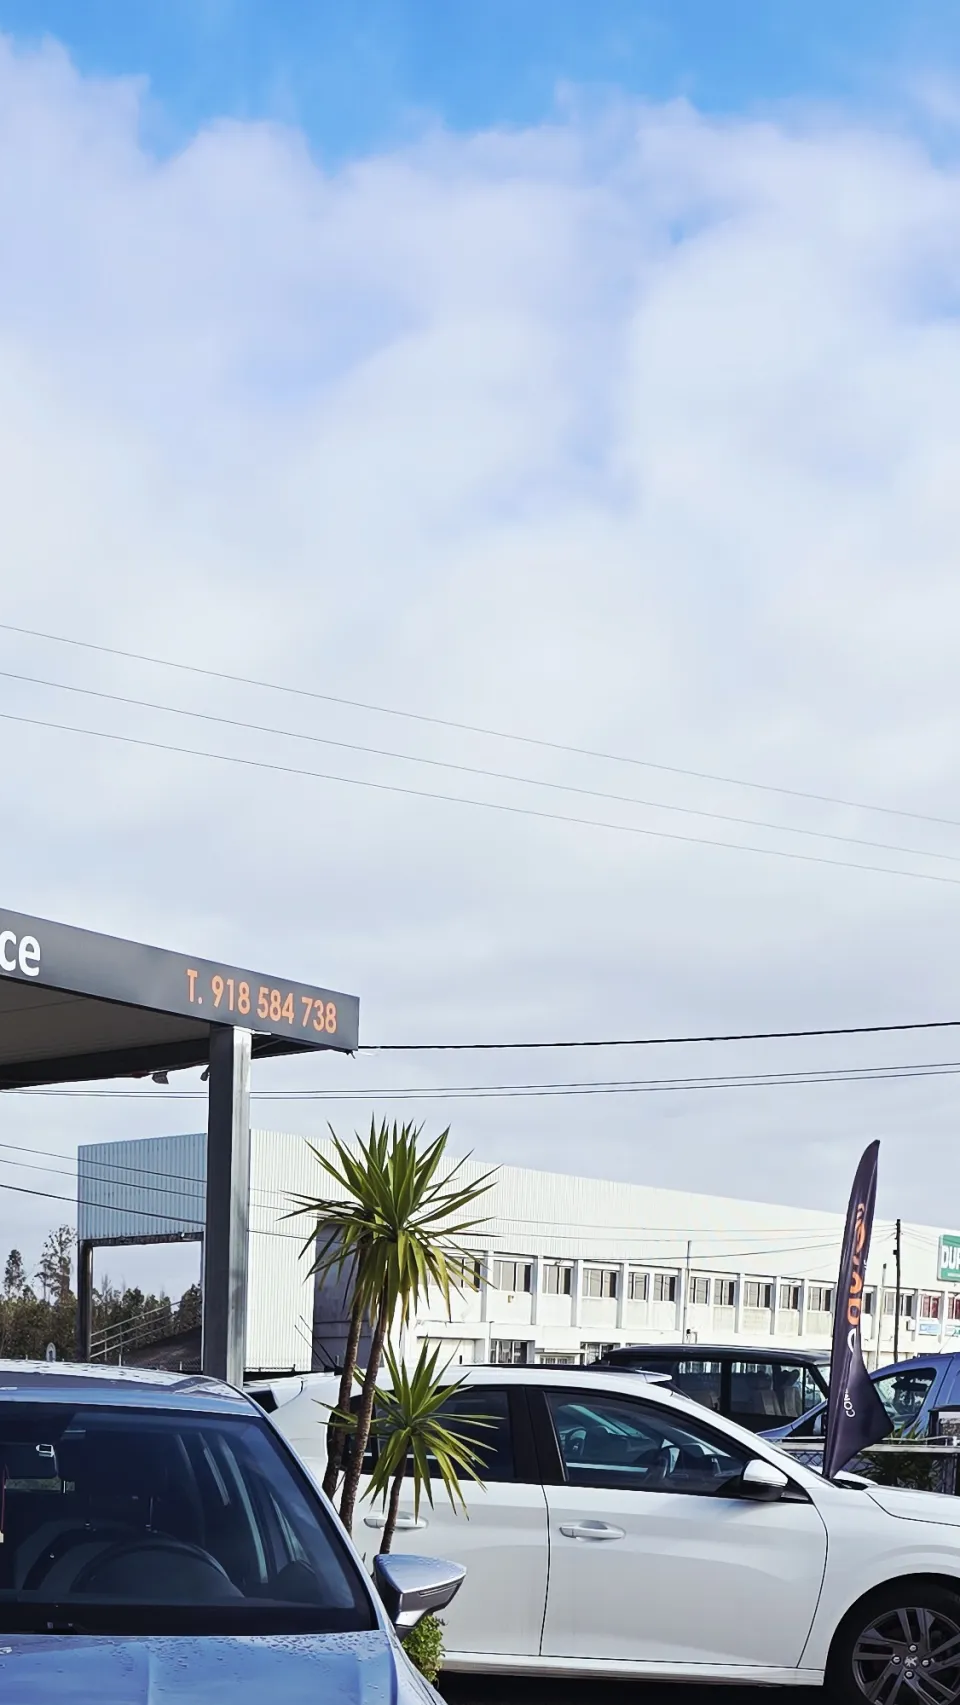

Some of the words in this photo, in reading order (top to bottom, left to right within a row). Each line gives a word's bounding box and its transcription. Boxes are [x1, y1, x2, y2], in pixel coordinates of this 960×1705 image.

[187, 969, 203, 1005] T.
[211, 975, 251, 1015] 918
[257, 986, 295, 1025] 584
[301, 996, 337, 1034] 738
